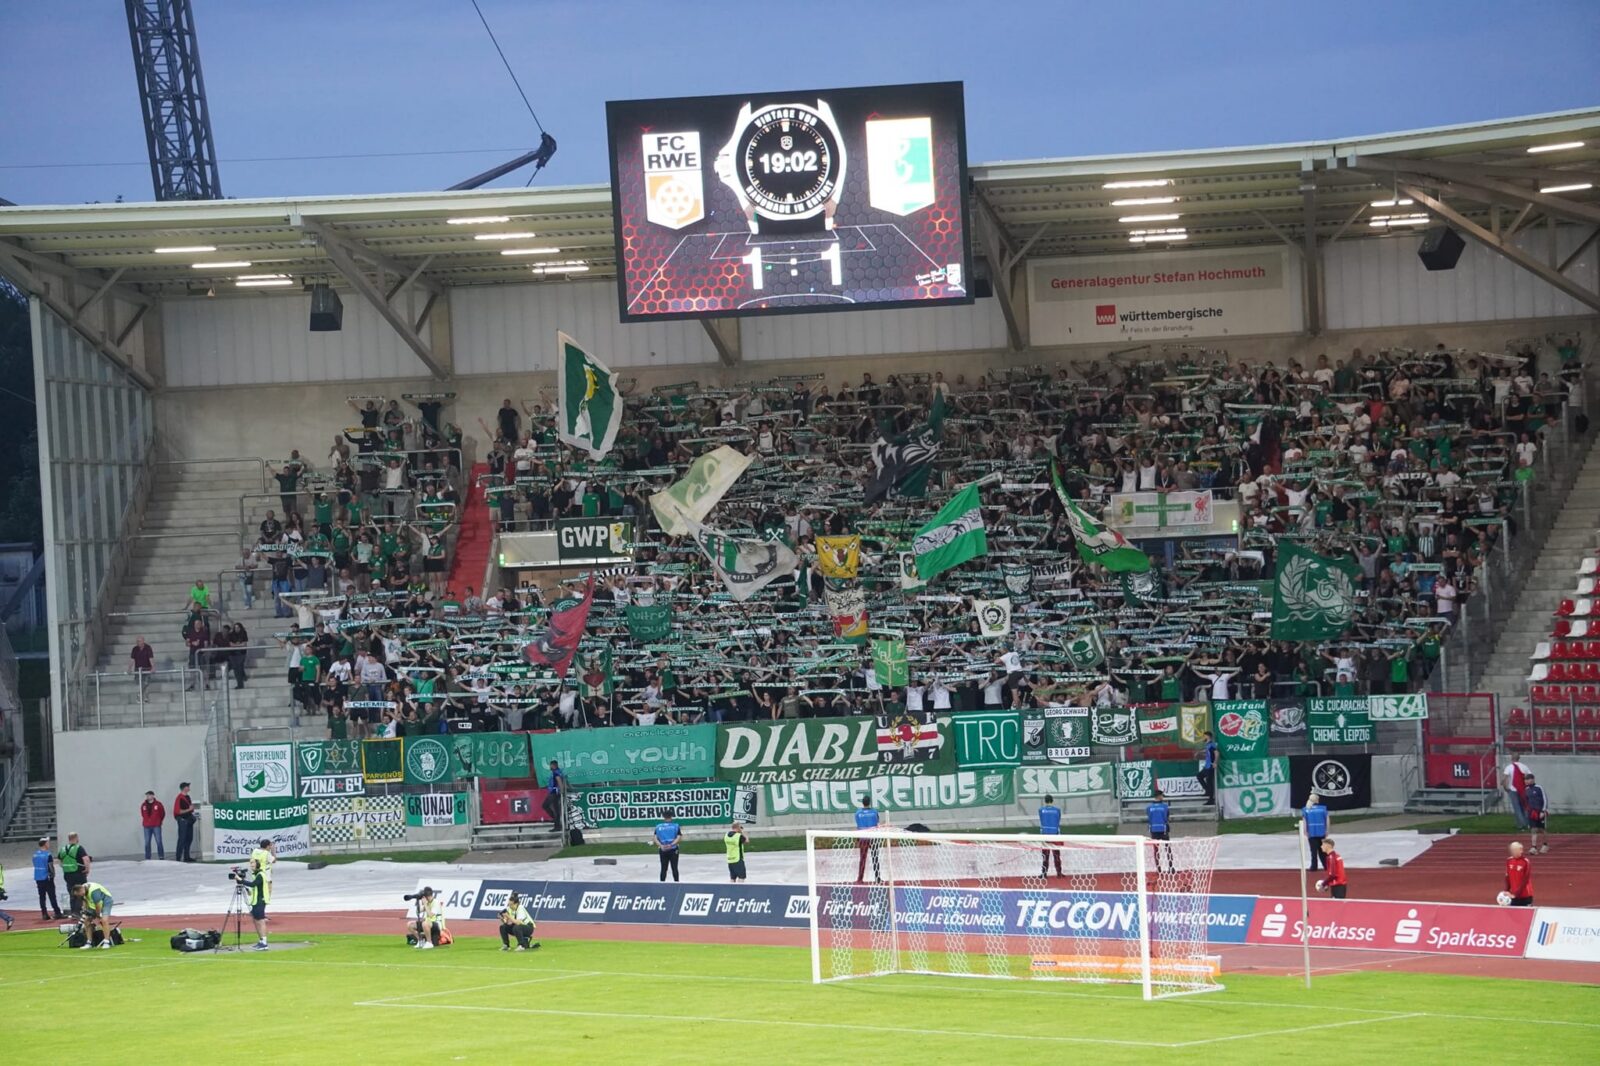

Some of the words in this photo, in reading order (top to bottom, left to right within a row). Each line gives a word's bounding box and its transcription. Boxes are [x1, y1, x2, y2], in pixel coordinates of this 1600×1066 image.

[754, 109, 795, 127] VINTAGE
[656, 136, 686, 151] FC
[647, 153, 698, 169] RWE
[759, 151, 818, 174] 19:02
[1051, 274, 1151, 289] Generalagentur
[1153, 271, 1195, 283] Stefan
[1198, 267, 1266, 281] Hochmuth
[1119, 307, 1223, 322] württembergische
[561, 525, 609, 548] GWP
[1310, 699, 1325, 711] LAS
[1327, 699, 1369, 711] CUCARACHAS
[955, 719, 1018, 761] TRC
[1313, 729, 1341, 741] CHEMIE
[1344, 729, 1370, 741] LEIPZIG
[240, 750, 287, 760] SPORTSFREUNDE
[1049, 748, 1089, 757] BRIGADE
[740, 769, 797, 784] ULTRAS
[803, 765, 861, 782] CHEMIE
[866, 763, 924, 778] LEIPZIG
[1022, 766, 1104, 793] SKINS
[301, 779, 335, 796] ZONA
[345, 777, 362, 792] 64
[588, 793, 629, 805] GEGEN
[633, 789, 730, 804] REPRESSIONEN
[1239, 787, 1274, 814] 03
[214, 808, 234, 820] BSG
[236, 809, 271, 821] CHEMIE
[274, 804, 308, 819] LEIPZIG
[589, 808, 616, 820] UND
[620, 803, 722, 819] ÜBERWACHUNG
[446, 890, 475, 908] AG
[484, 893, 508, 908] SWE
[532, 895, 567, 909] Erfurt.
[582, 894, 607, 910] SWE
[612, 896, 632, 911] Für
[632, 896, 667, 912] Erfurt.
[683, 896, 710, 913] SWE
[716, 897, 736, 913] Für
[736, 898, 772, 914] Erfurt.
[823, 899, 845, 916] Für
[927, 896, 957, 909] JOBS
[957, 894, 980, 909] FÜR
[894, 911, 946, 925] DIGITALE
[943, 911, 1006, 926] LÖSUNGEN
[1016, 899, 1136, 931] TECCON
[1291, 920, 1376, 942] Sparkasse
[1426, 927, 1517, 949] Sparkasse
